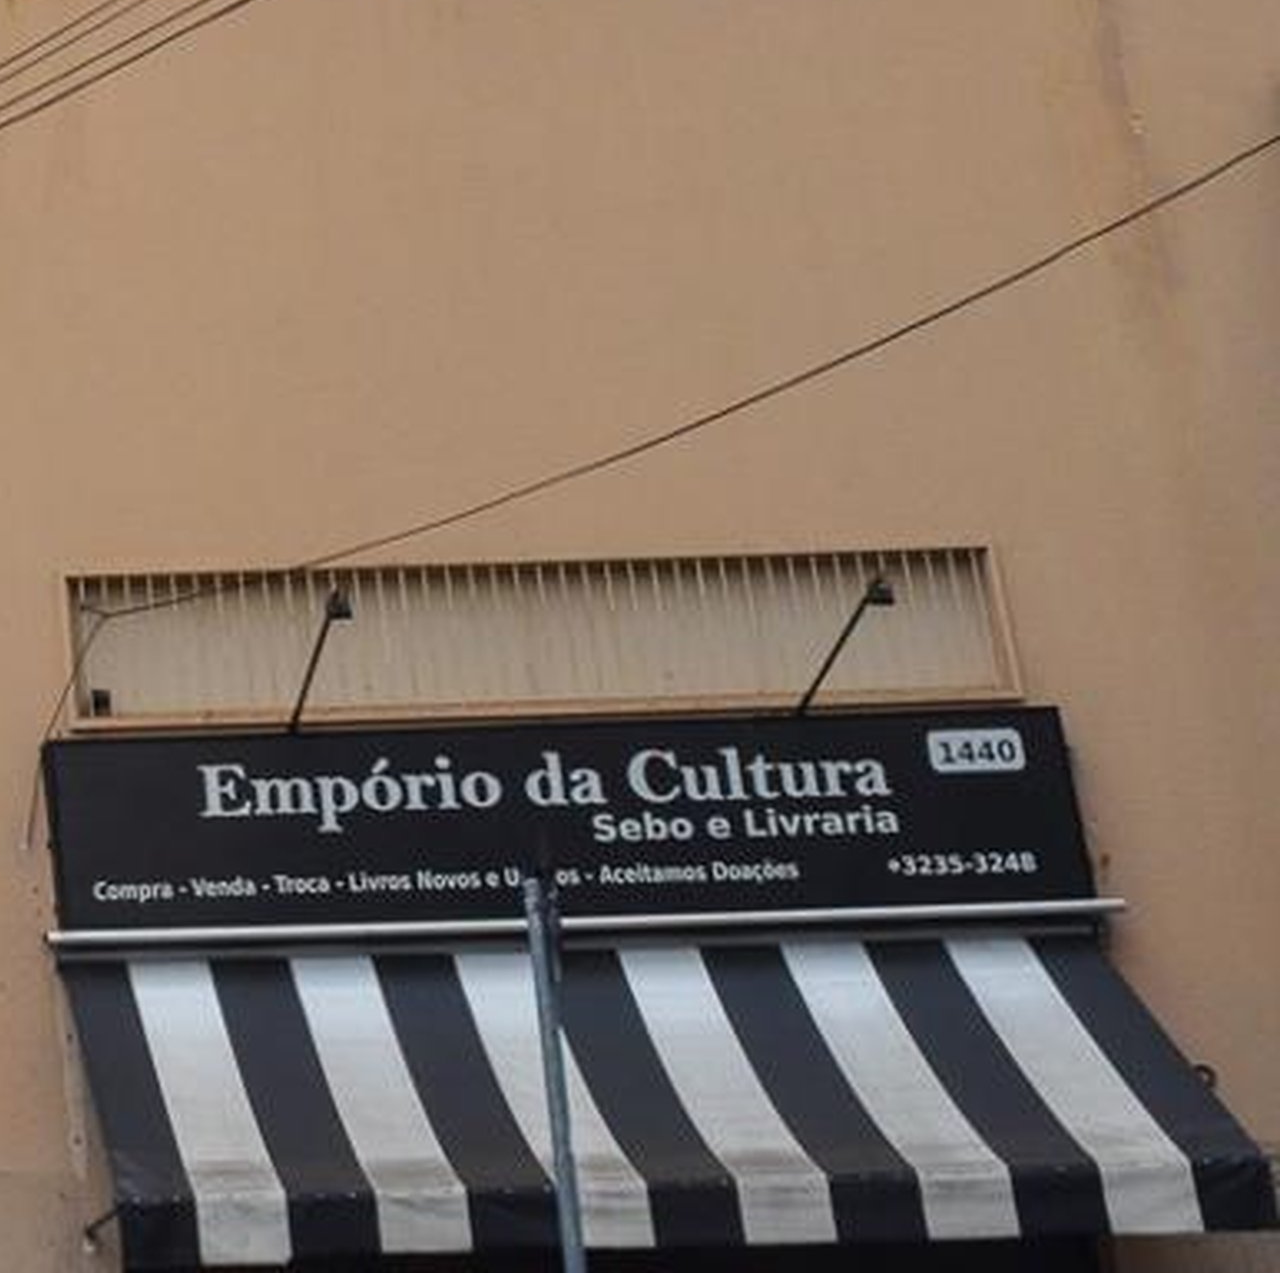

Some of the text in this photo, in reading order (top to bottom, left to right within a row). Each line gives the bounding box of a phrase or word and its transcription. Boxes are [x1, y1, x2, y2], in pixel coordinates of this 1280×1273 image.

[940, 740, 1016, 765] 1440
[197, 746, 892, 832] Empório da Cultura
[592, 804, 900, 843] Sebo e Livraria
[93, 880, 174, 903] Compra
[190, 875, 257, 897] Venda
[272, 873, 330, 894] Troca
[348, 871, 411, 892] Livros
[416, 869, 482, 890] Novos
[485, 871, 500, 886] e
[600, 863, 707, 886] Aceitamos
[712, 859, 800, 883] Doações
[901, 851, 1039, 875] 3235-3248
